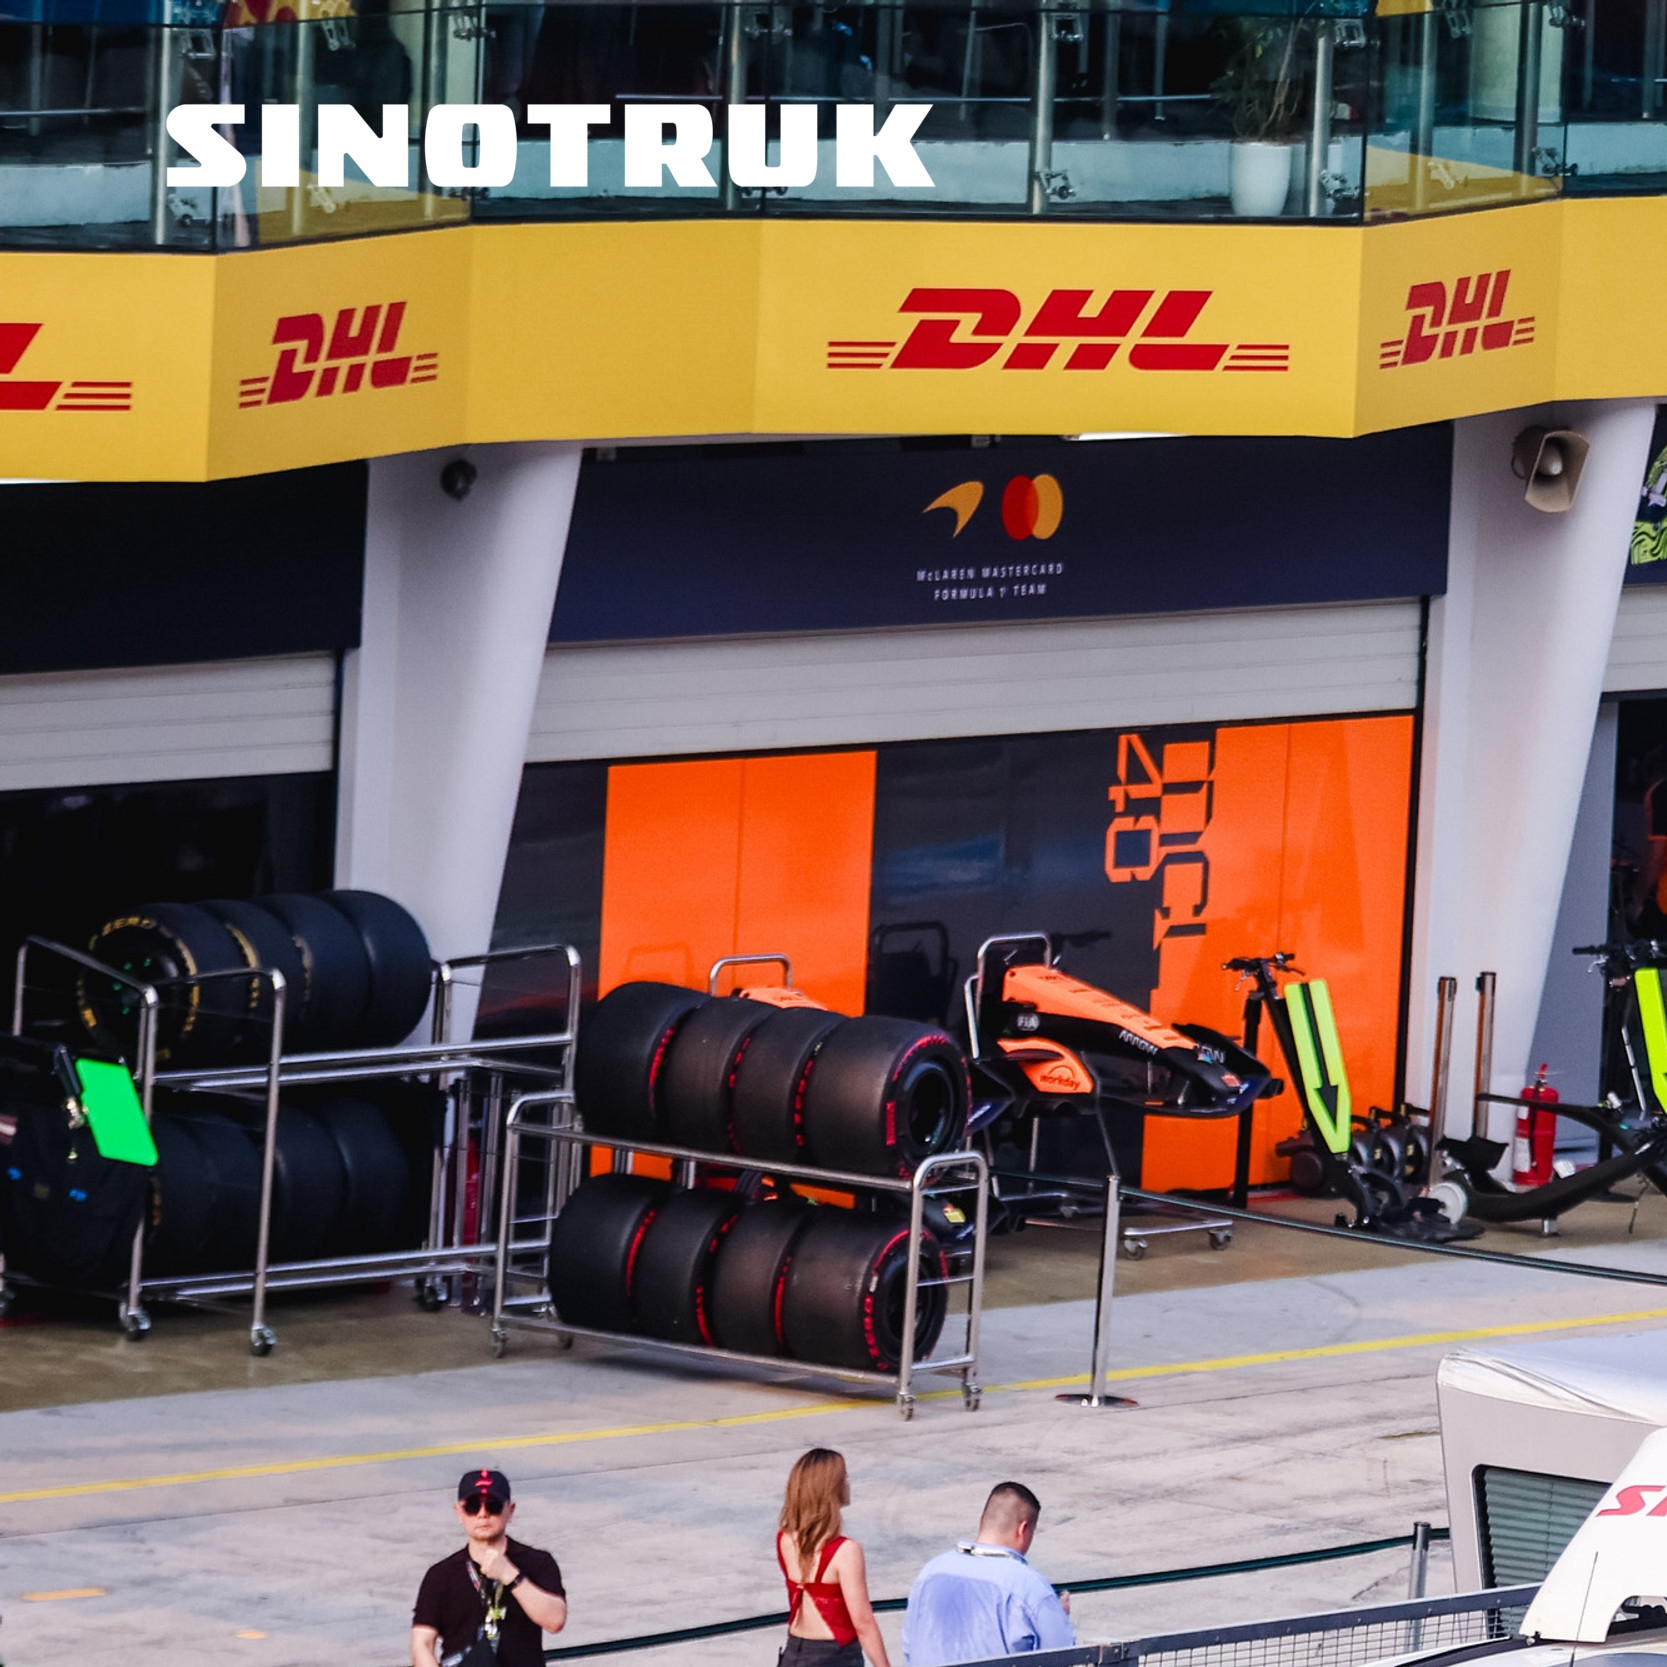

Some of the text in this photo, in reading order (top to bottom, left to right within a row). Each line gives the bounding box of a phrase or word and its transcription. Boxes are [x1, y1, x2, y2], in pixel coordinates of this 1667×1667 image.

[890, 288, 1230, 371] DHL
[1403, 269, 1514, 366] DHL
[267, 301, 412, 405] DHL
[934, 586, 994, 600] FORMULA
[1013, 583, 1047, 596] TEAM
[981, 562, 1064, 579] MASTERCARD
[1041, 1072, 1081, 1091] workday
